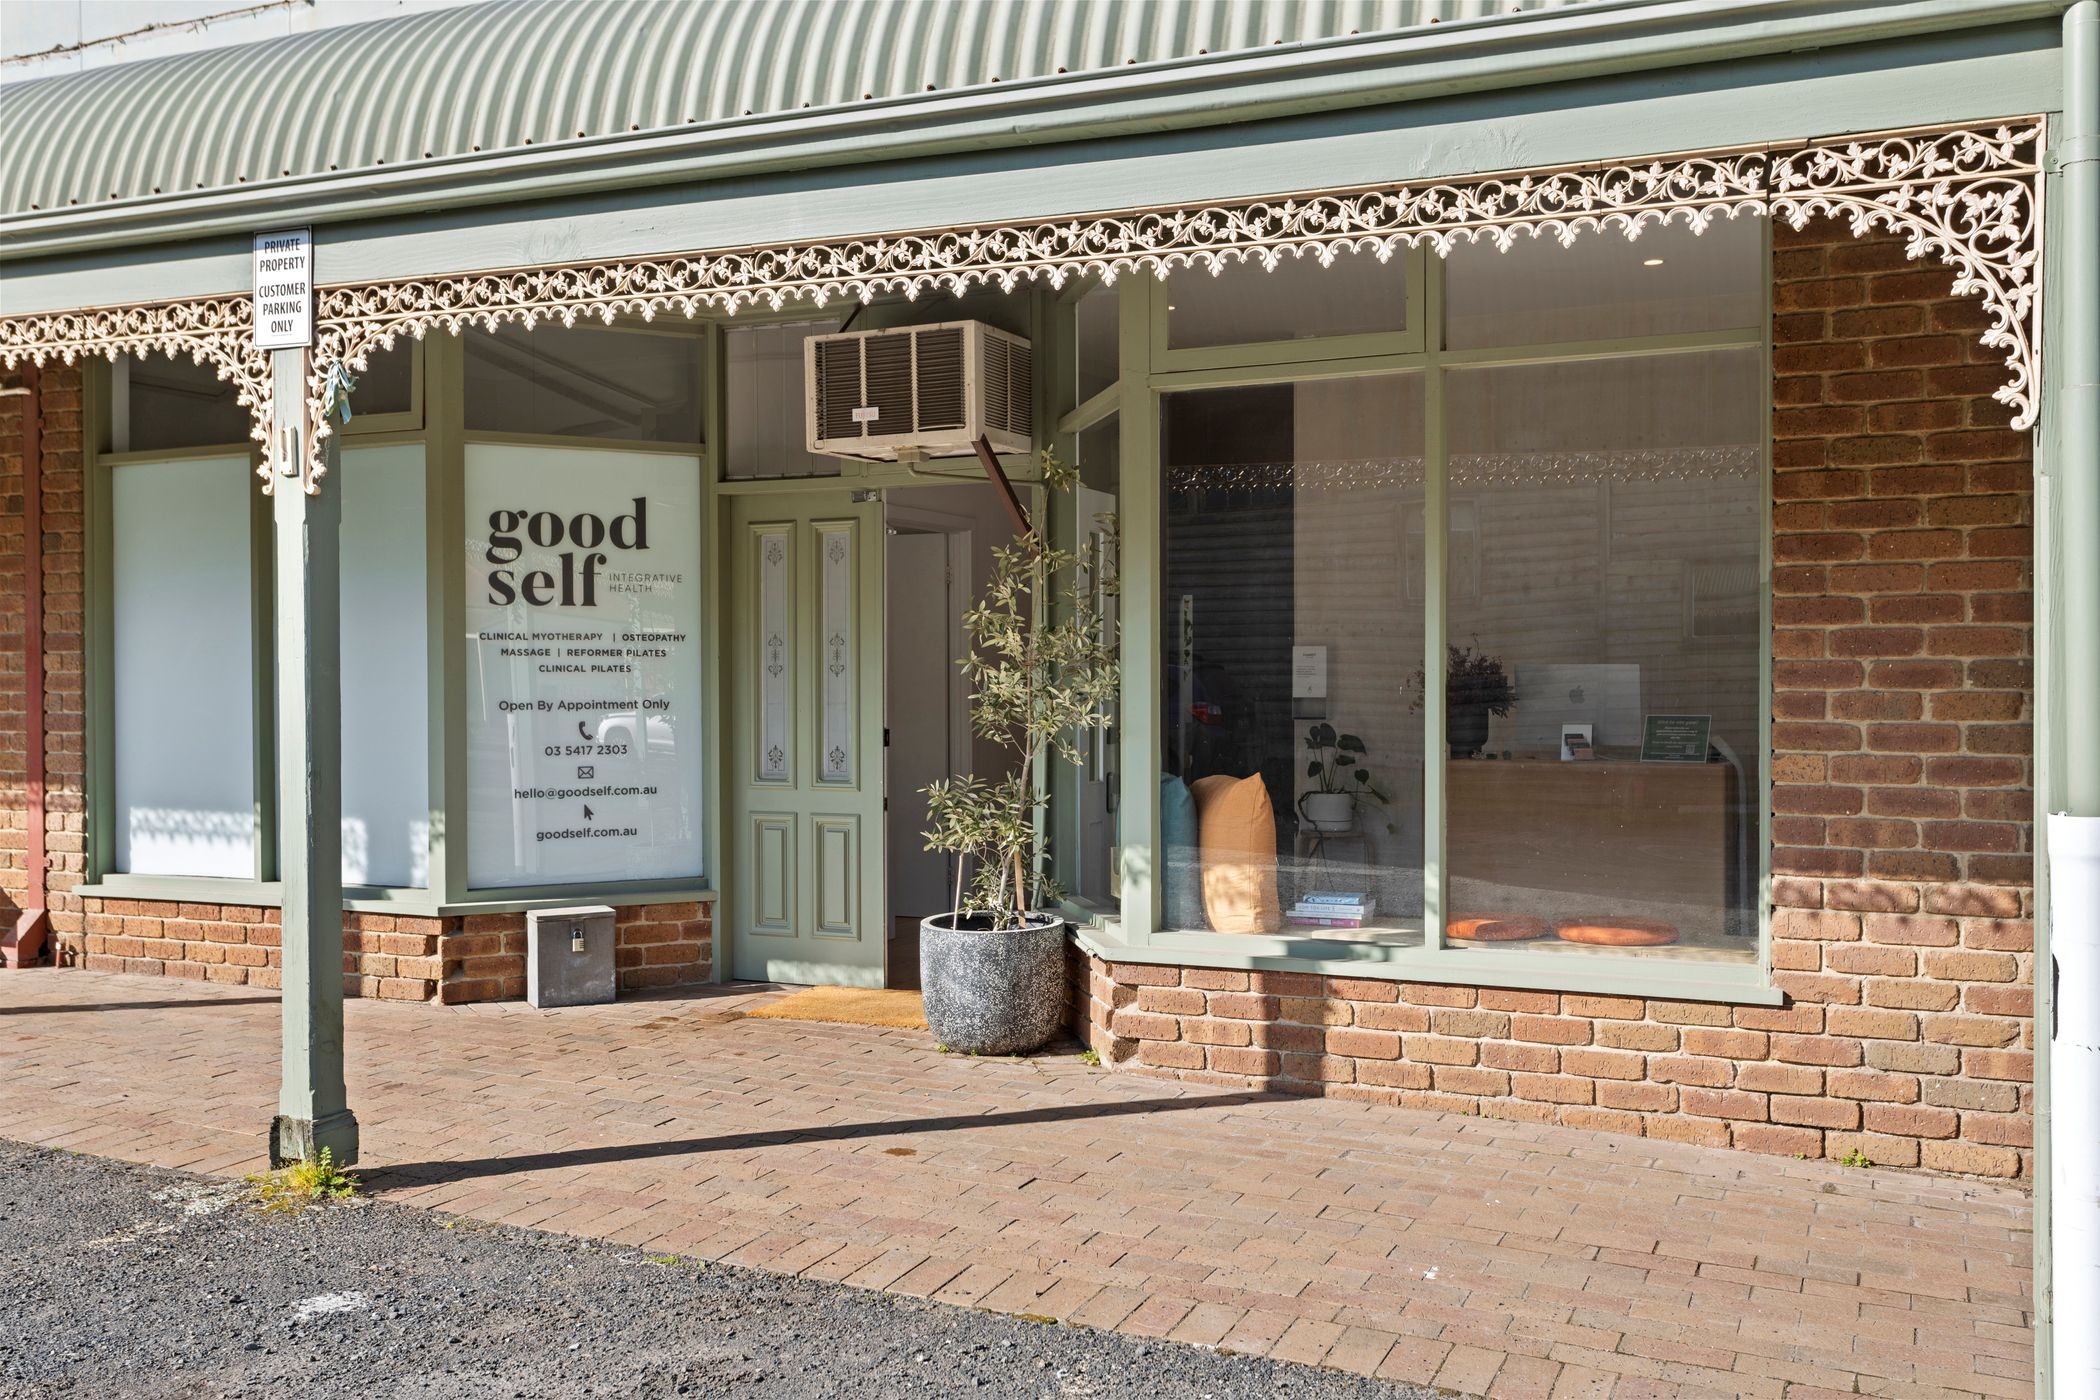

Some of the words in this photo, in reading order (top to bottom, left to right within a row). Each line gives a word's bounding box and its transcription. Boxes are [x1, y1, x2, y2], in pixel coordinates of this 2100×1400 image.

[264, 238, 301, 254] PRIVATE
[259, 256, 306, 272] PROPERTY
[258, 282, 306, 298] CUSTOMER
[262, 301, 302, 316] PARKING
[270, 319, 294, 333] ONLY
[855, 411, 876, 419] FUJSU
[485, 496, 650, 565] good
[488, 552, 607, 607] self
[609, 573, 683, 584] INTEGRATIVE
[609, 584, 653, 593] HEALTH
[479, 632, 529, 641] CLINICAL
[532, 632, 603, 641] MYOTHERAPY
[621, 633, 687, 643] OSTEOPATHY
[500, 648, 551, 657] MASSAGE
[566, 648, 623, 657] REFORMER
[626, 648, 667, 658] PILATES
[538, 664, 587, 673] CLINICAL
[591, 664, 632, 673] PILATES
[498, 700, 533, 713] Open
[537, 700, 553, 712] By
[557, 699, 639, 712] Appointment
[642, 698, 671, 711] Only
[544, 745, 561, 756] 03
[565, 745, 593, 756] 5417
[597, 744, 628, 755] 2303
[514, 785, 658, 800] hello@goodself.com.au
[536, 827, 638, 842] goodself.com.au
